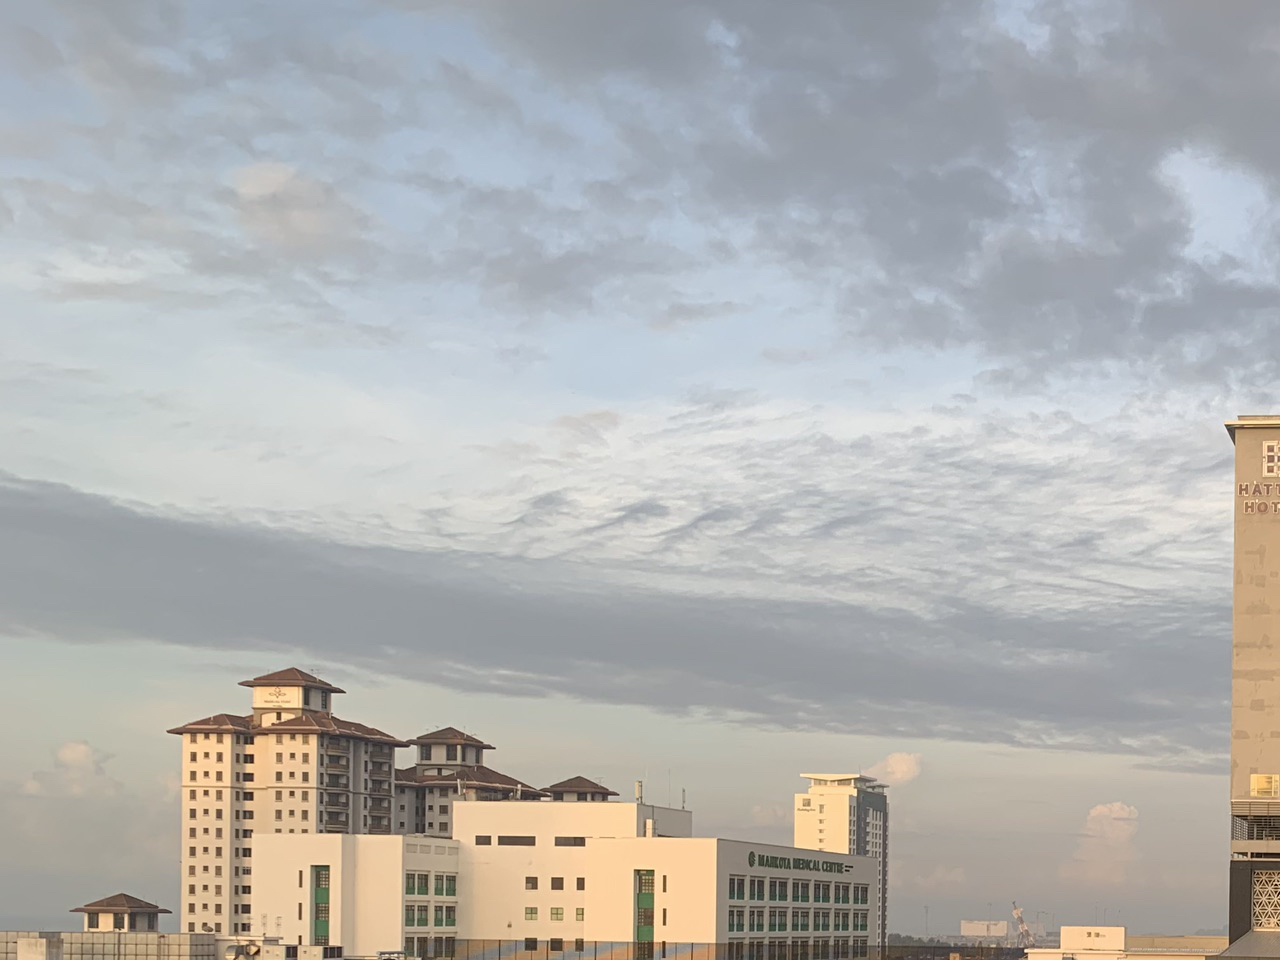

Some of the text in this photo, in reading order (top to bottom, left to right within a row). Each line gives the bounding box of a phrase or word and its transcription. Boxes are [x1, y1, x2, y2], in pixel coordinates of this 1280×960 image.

[758, 854, 791, 870] MAHKOTA
[792, 857, 821, 872] MEDICAL
[822, 860, 844, 874] CENTRE
